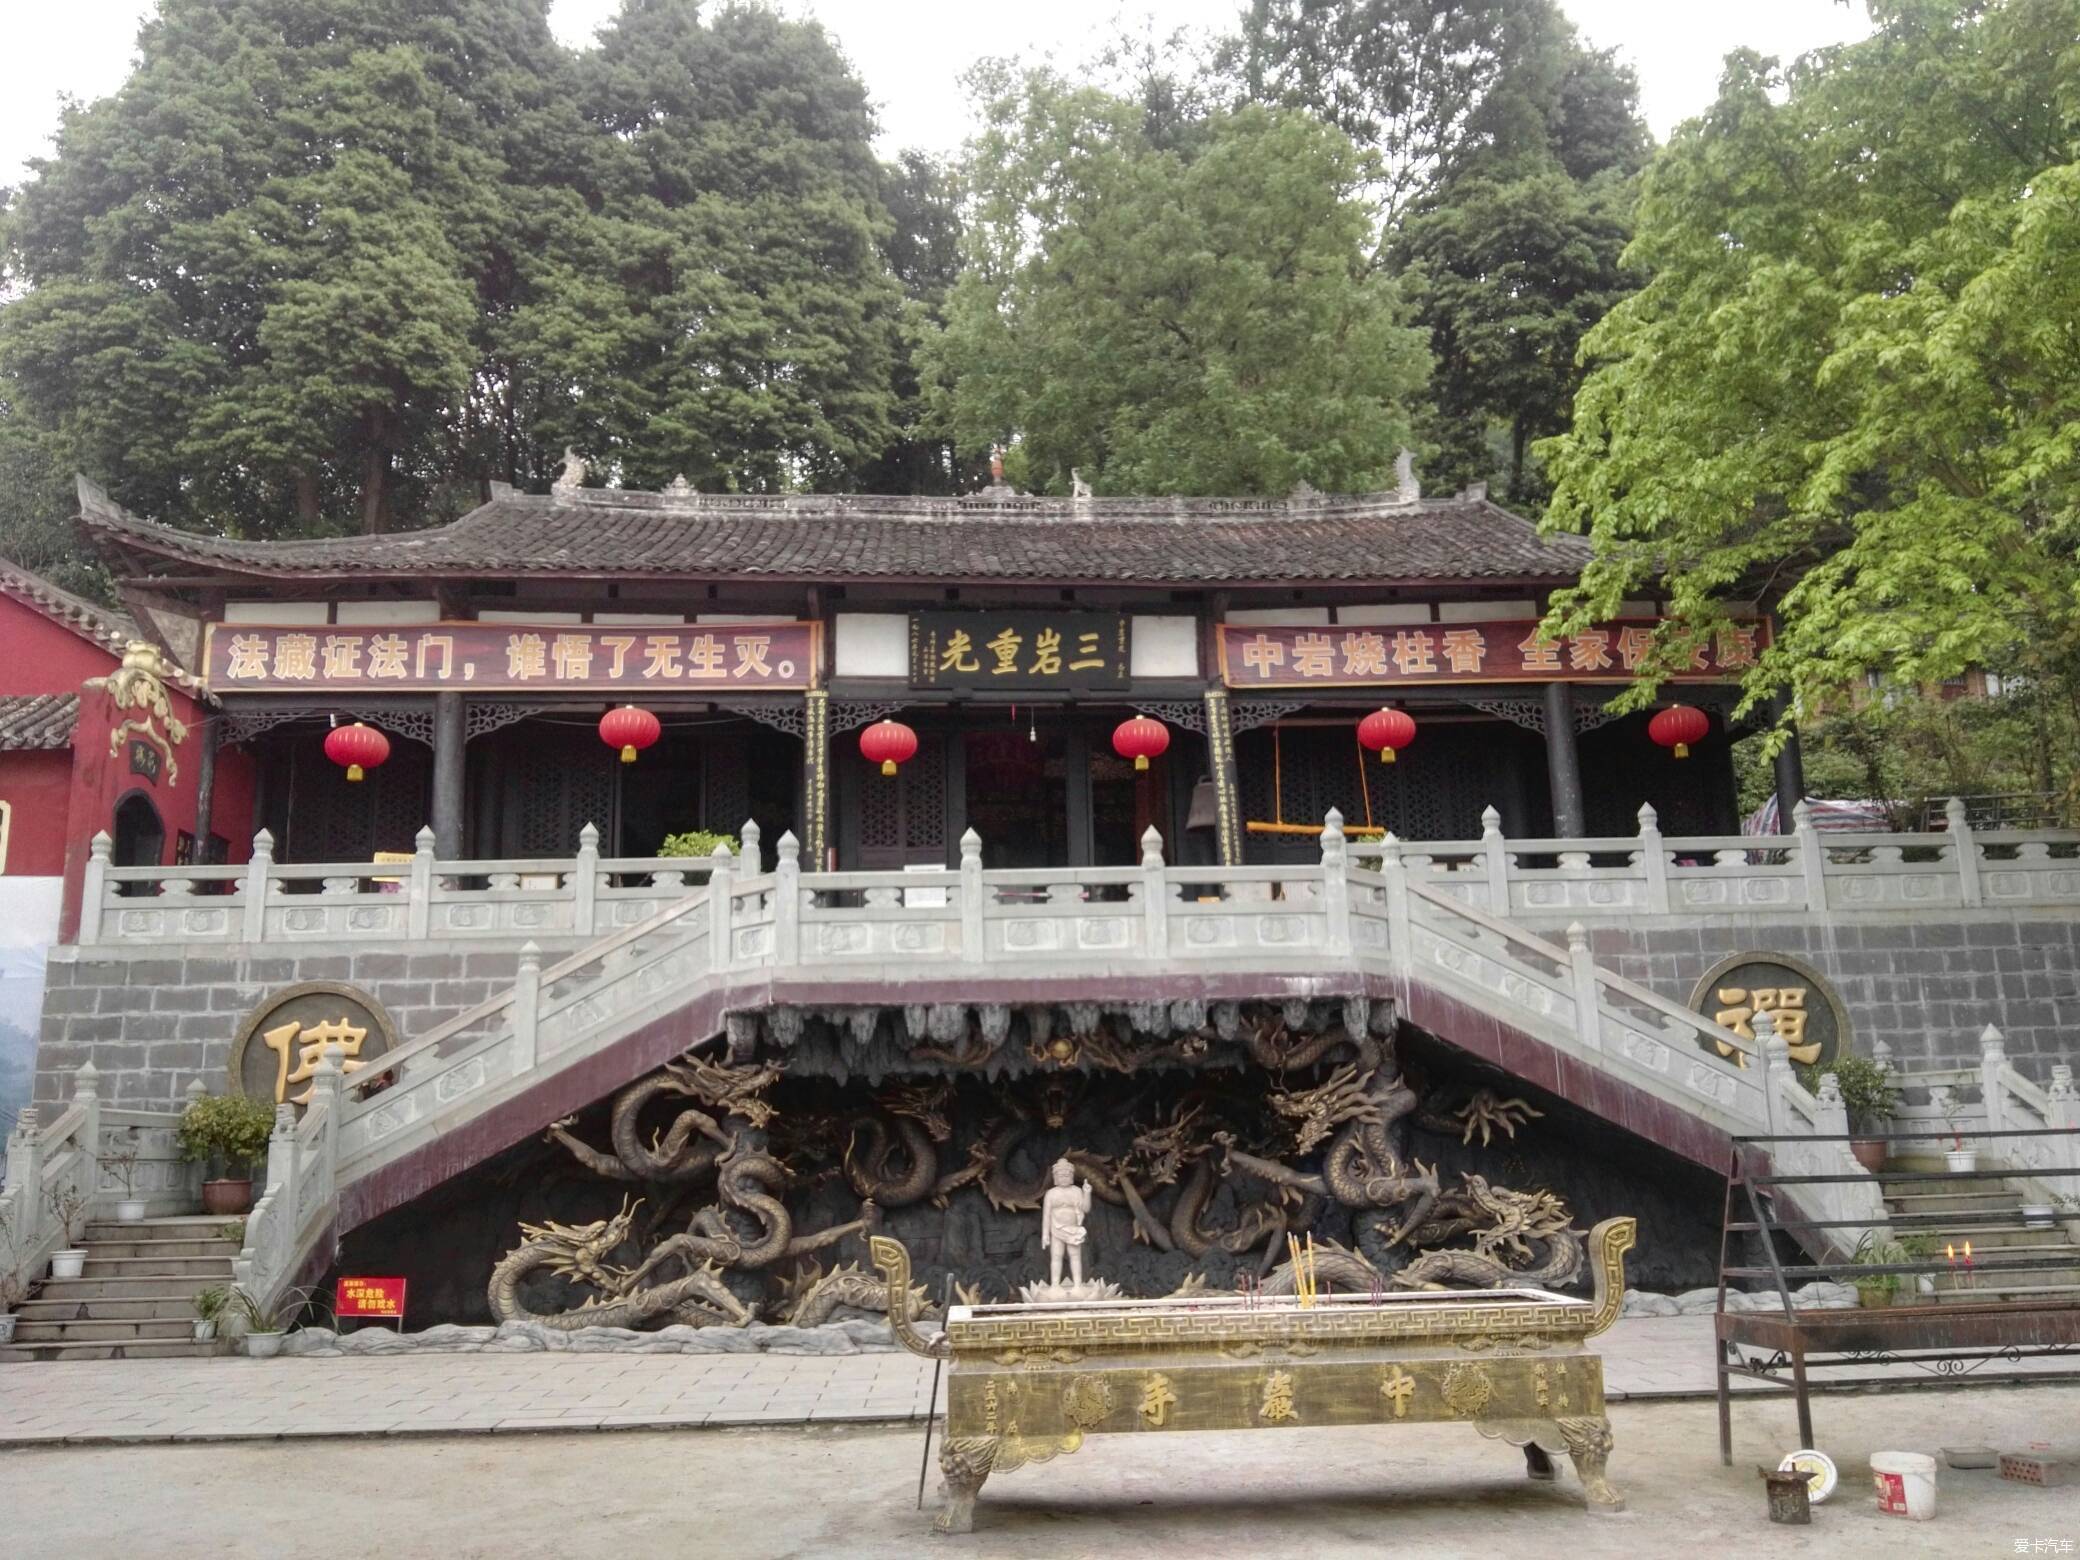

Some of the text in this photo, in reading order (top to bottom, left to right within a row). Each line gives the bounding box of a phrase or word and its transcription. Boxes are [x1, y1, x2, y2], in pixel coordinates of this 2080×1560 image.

[939, 627, 1105, 675] 三岩重光
[1242, 632, 1487, 678] 中岩烧柱香
